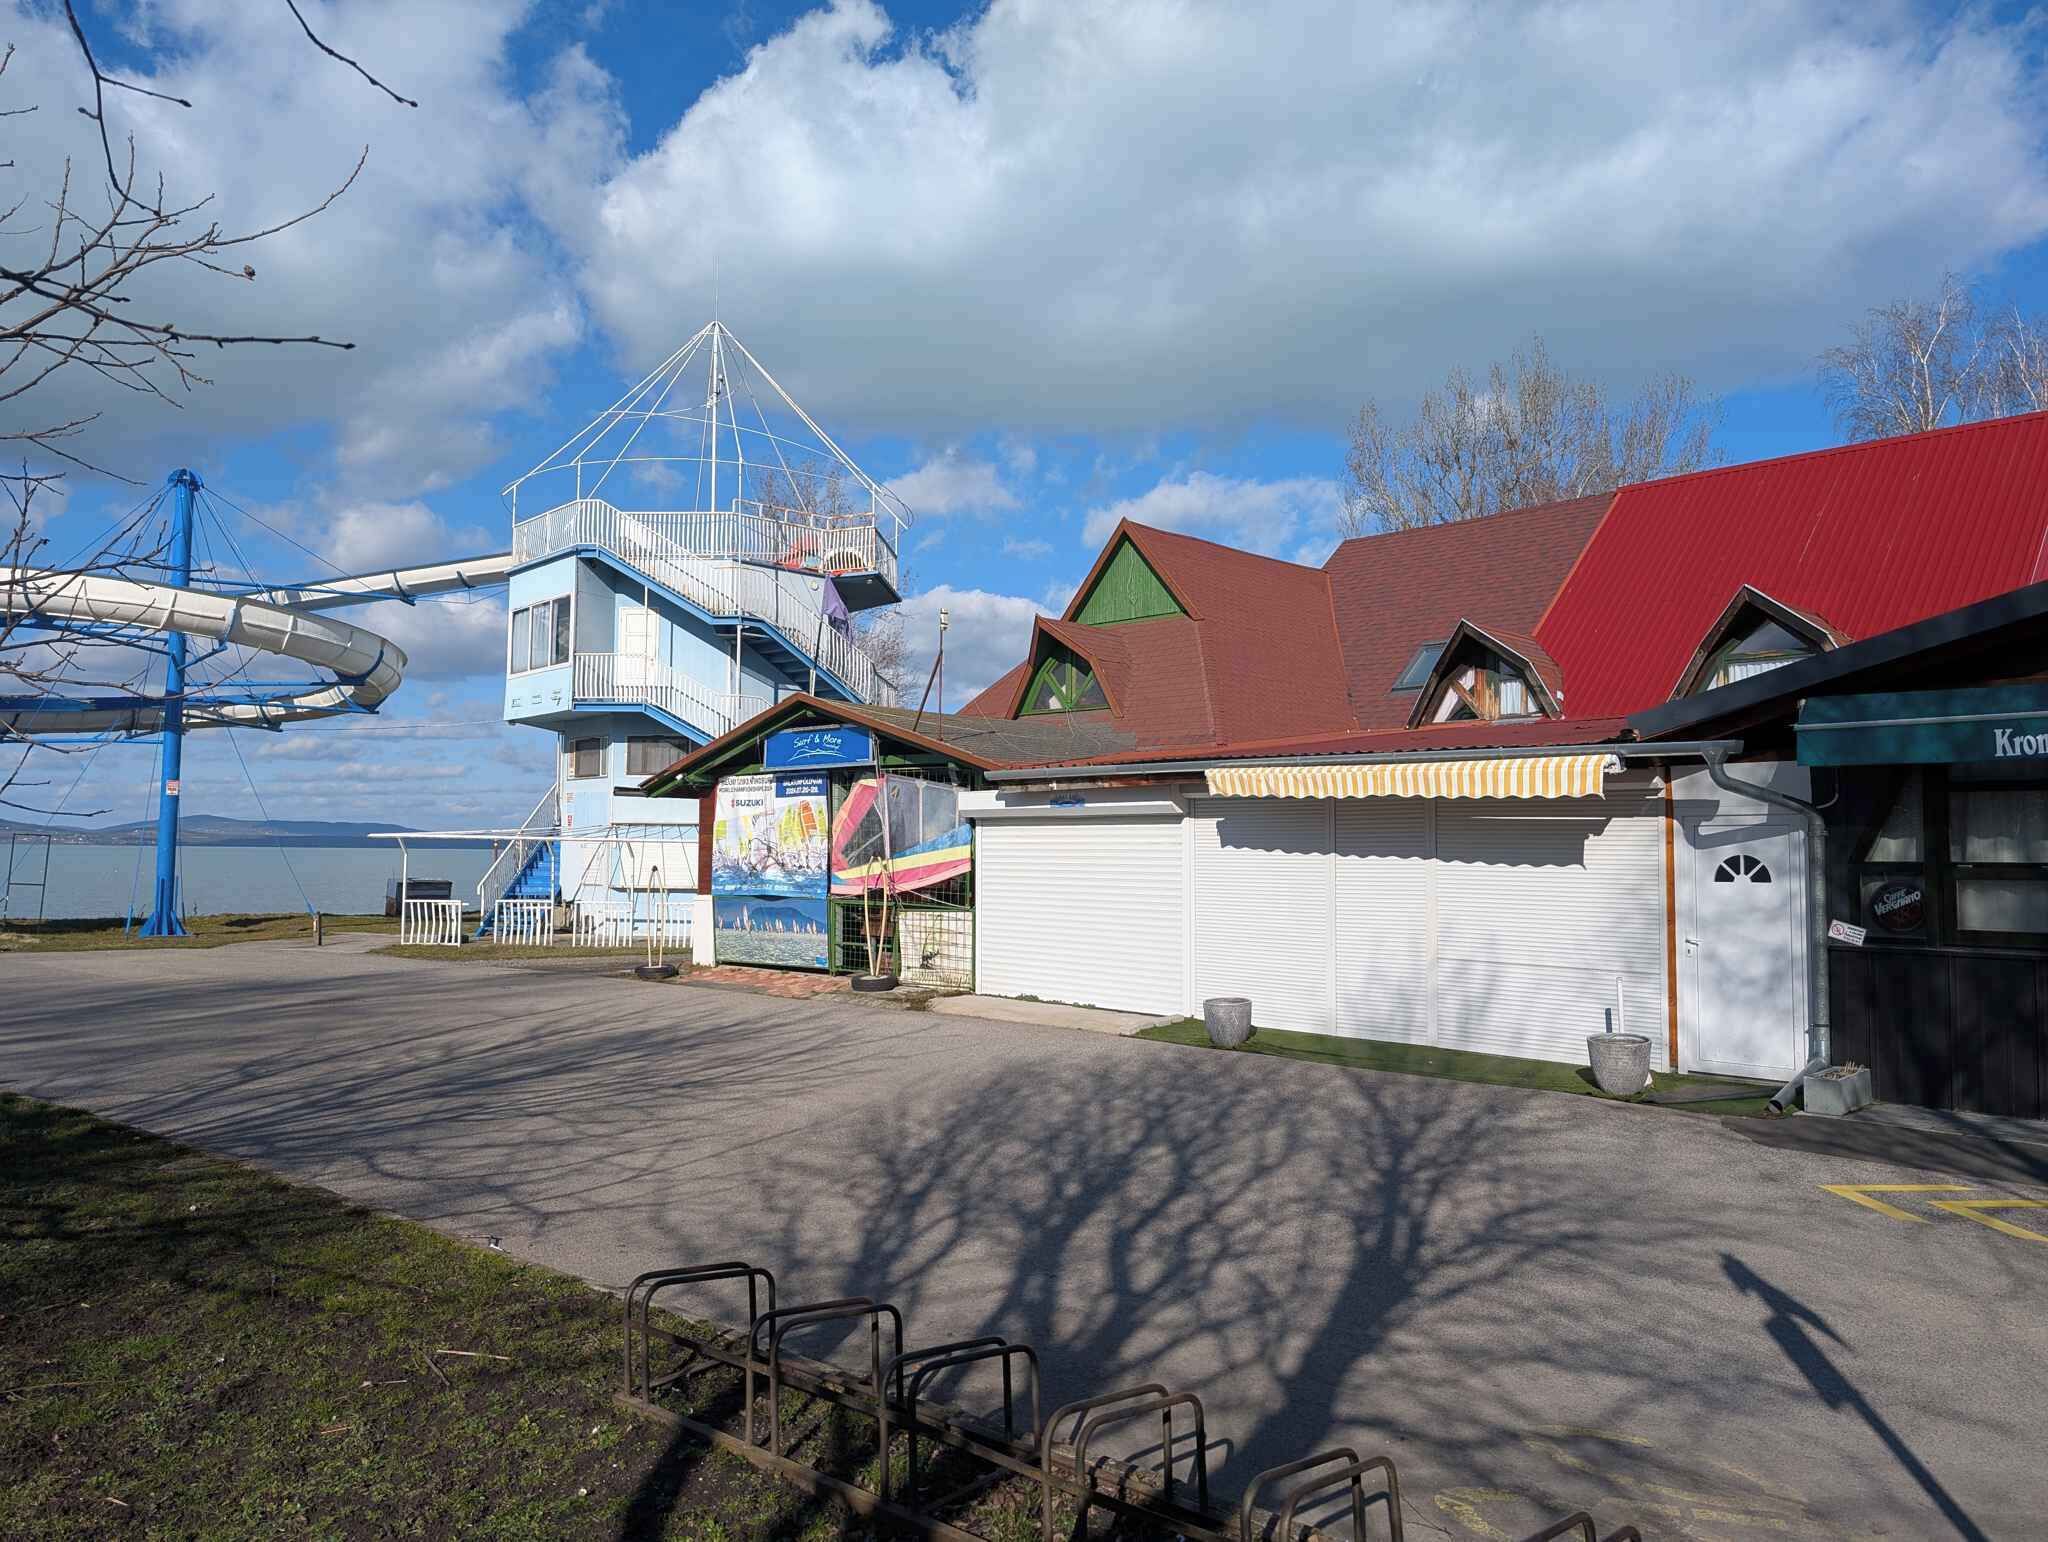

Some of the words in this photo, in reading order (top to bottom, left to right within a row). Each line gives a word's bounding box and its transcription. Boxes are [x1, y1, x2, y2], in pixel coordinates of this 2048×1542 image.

[793, 735, 813, 748] Surf
[823, 734, 842, 745] More
[735, 799, 764, 807] SUZUKI
